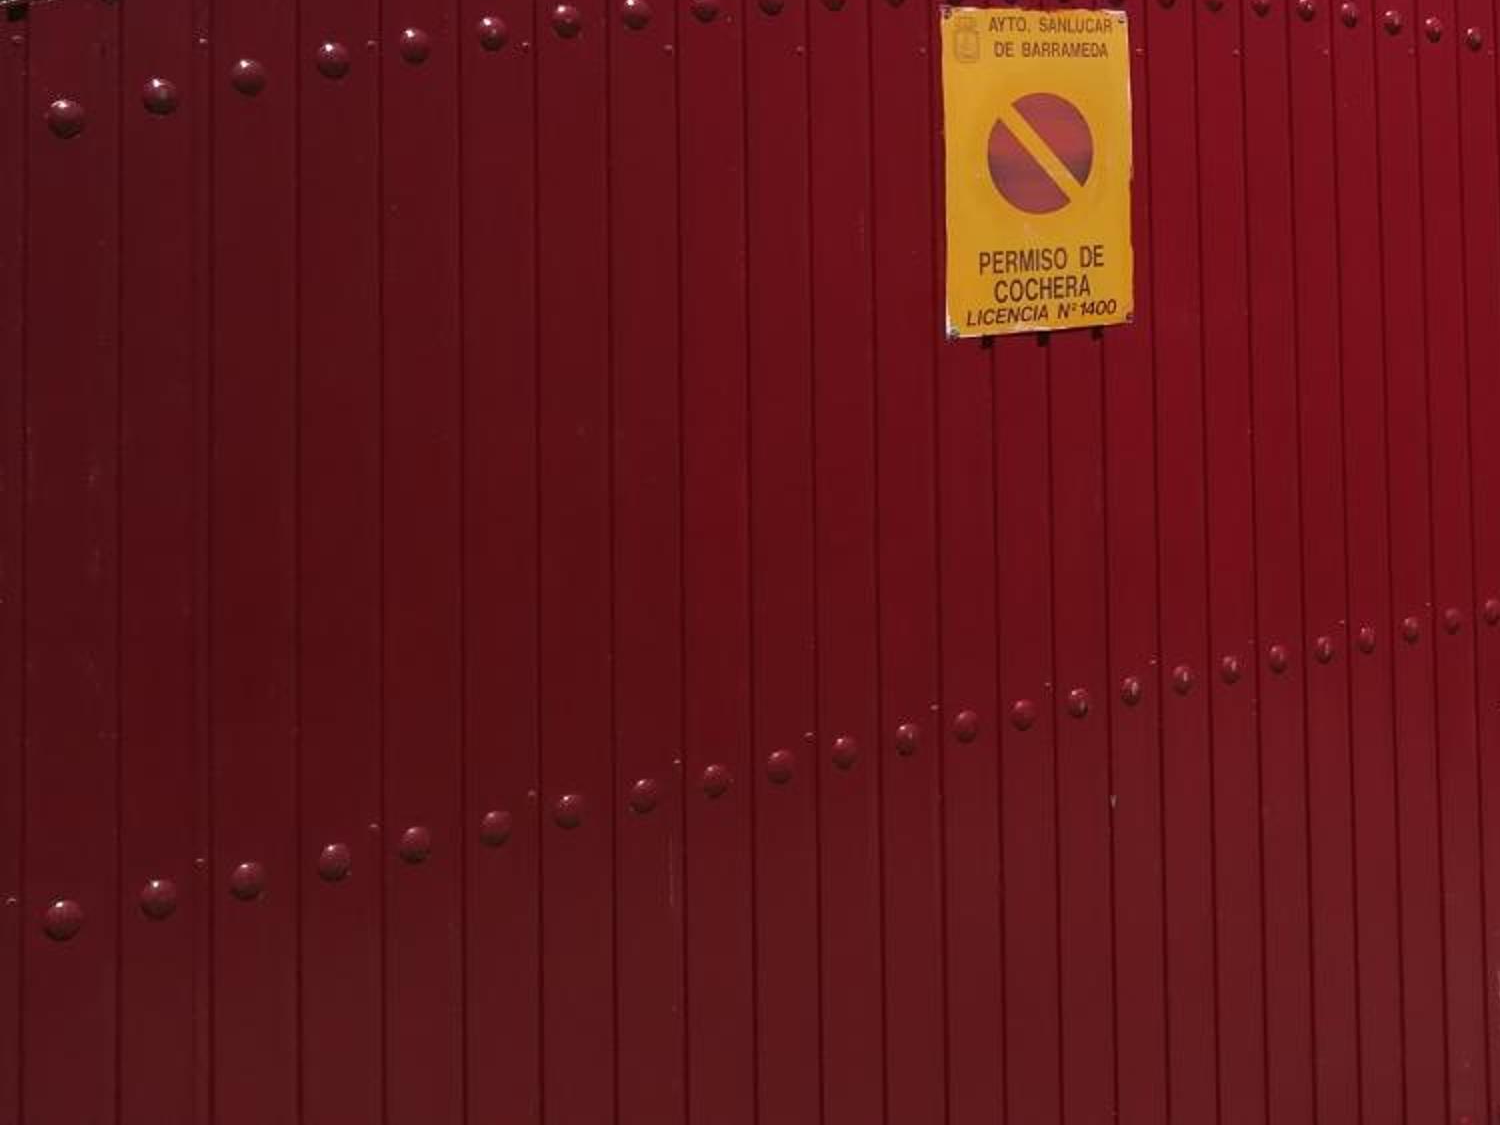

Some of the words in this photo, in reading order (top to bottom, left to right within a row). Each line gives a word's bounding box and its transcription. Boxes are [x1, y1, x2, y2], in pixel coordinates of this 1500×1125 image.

[1039, 16, 1113, 34] SANLUCAR
[994, 41, 1015, 58] DE
[1022, 41, 1109, 58] BARRAMEDA
[979, 246, 1067, 275] PERMISO
[1080, 244, 1105, 269] DE
[994, 274, 1091, 305] COCHERA
[966, 304, 1049, 327] LICENCIA
